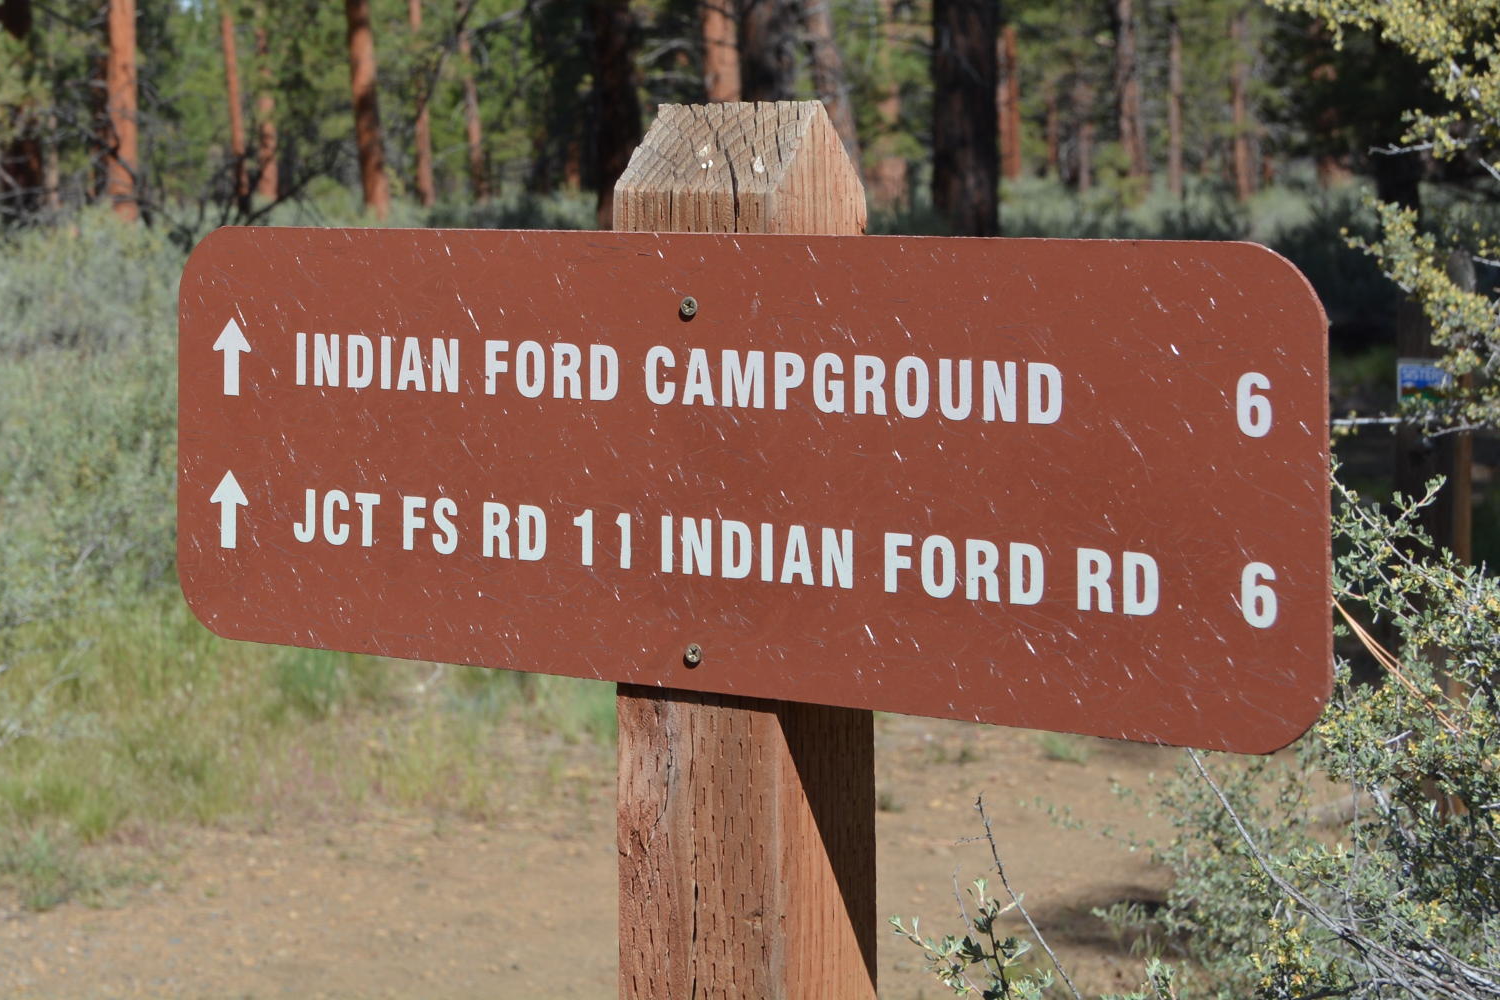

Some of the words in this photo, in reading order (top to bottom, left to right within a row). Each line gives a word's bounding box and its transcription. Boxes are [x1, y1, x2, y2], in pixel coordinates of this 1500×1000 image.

[296, 332, 459, 394] INDIAN
[485, 339, 619, 401] FORD
[643, 346, 1063, 425] CAMPGROUND
[1237, 372, 1272, 438] 6
[1403, 367, 1451, 382] SISTER
[293, 488, 380, 547] JCT
[403, 495, 458, 555] FS
[483, 502, 546, 562] RD
[573, 509, 632, 570] 11
[661, 513, 854, 590] INDIAN
[885, 533, 1044, 606] FORD
[1076, 547, 1159, 616] RD
[1241, 562, 1278, 629] 6
